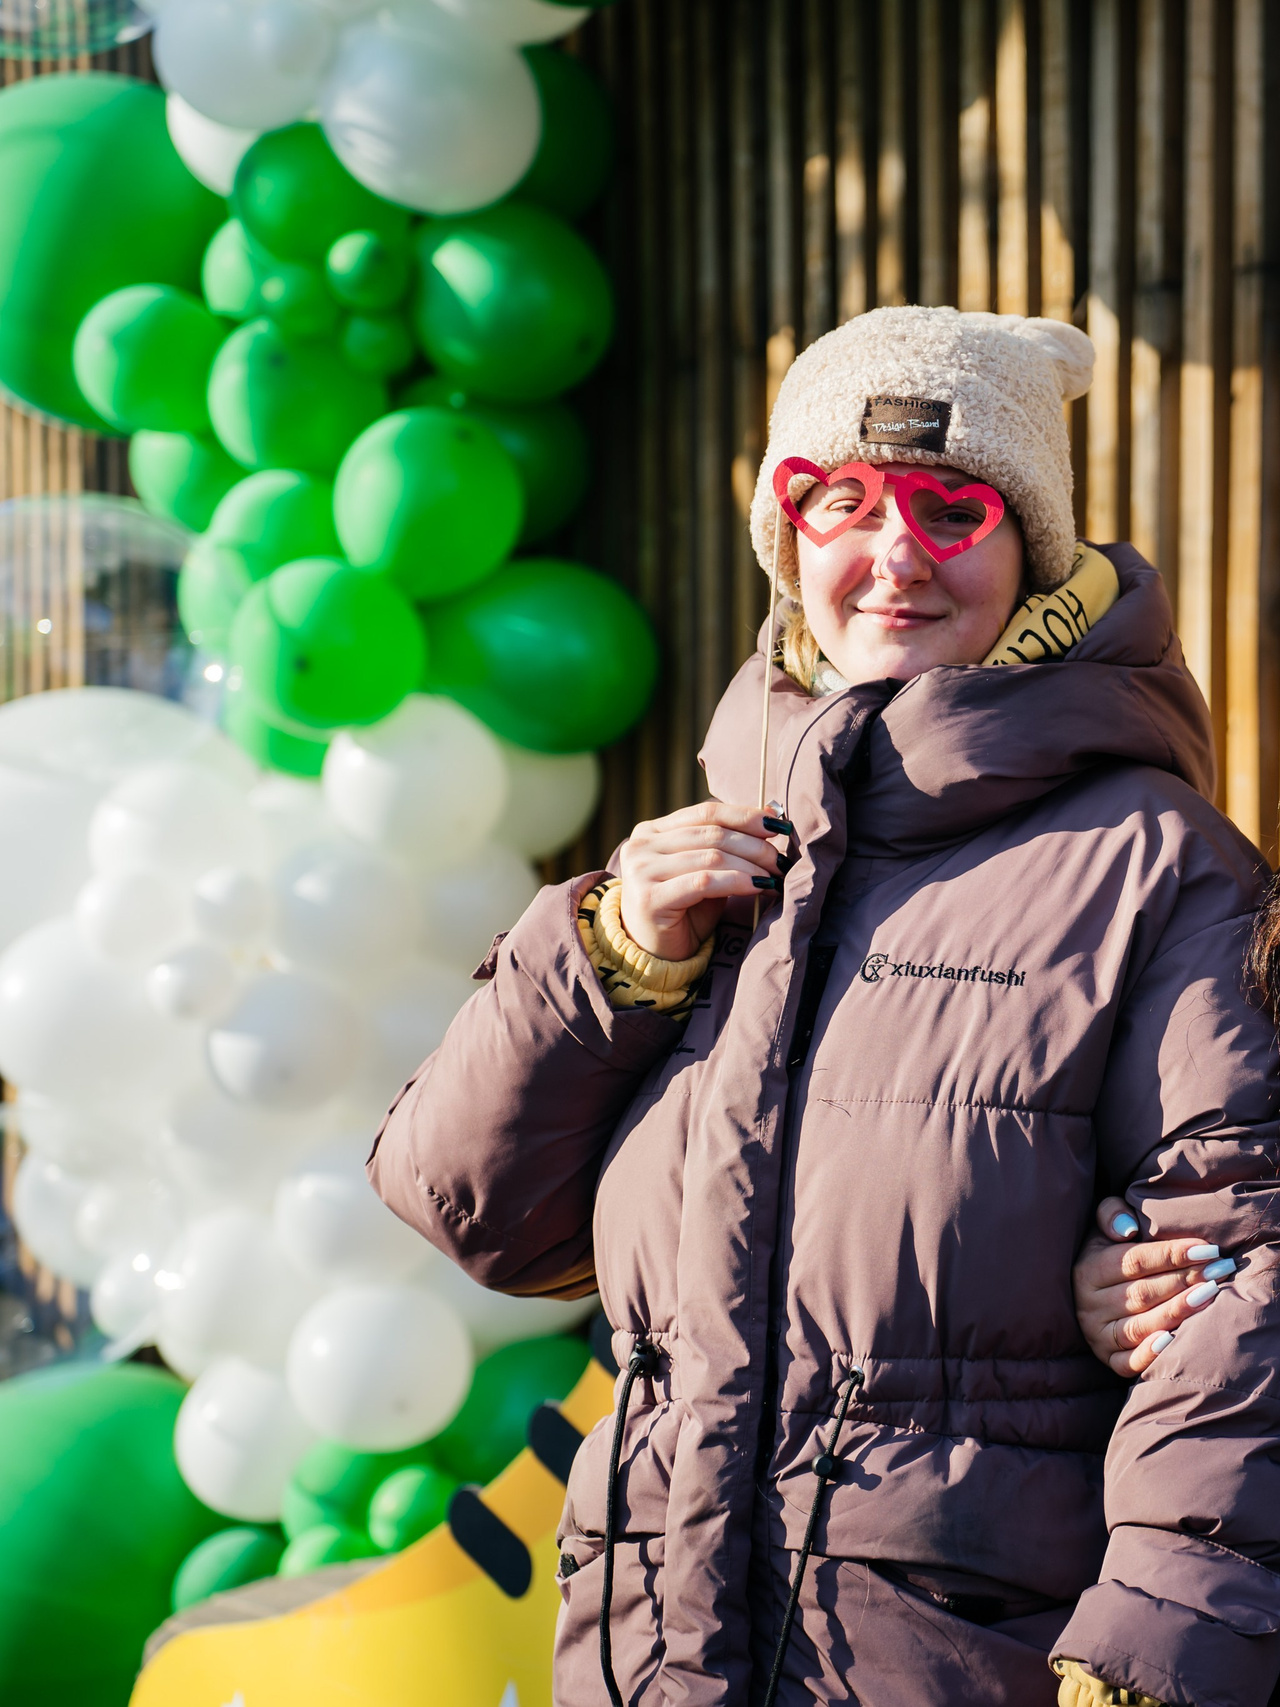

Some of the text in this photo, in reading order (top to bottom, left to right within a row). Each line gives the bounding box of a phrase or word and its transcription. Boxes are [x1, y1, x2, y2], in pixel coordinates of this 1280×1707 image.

[874, 398, 942, 413] FASHION
[872, 419, 940, 433] Design Brand
[890, 961, 1027, 986] xiuxianfushi
